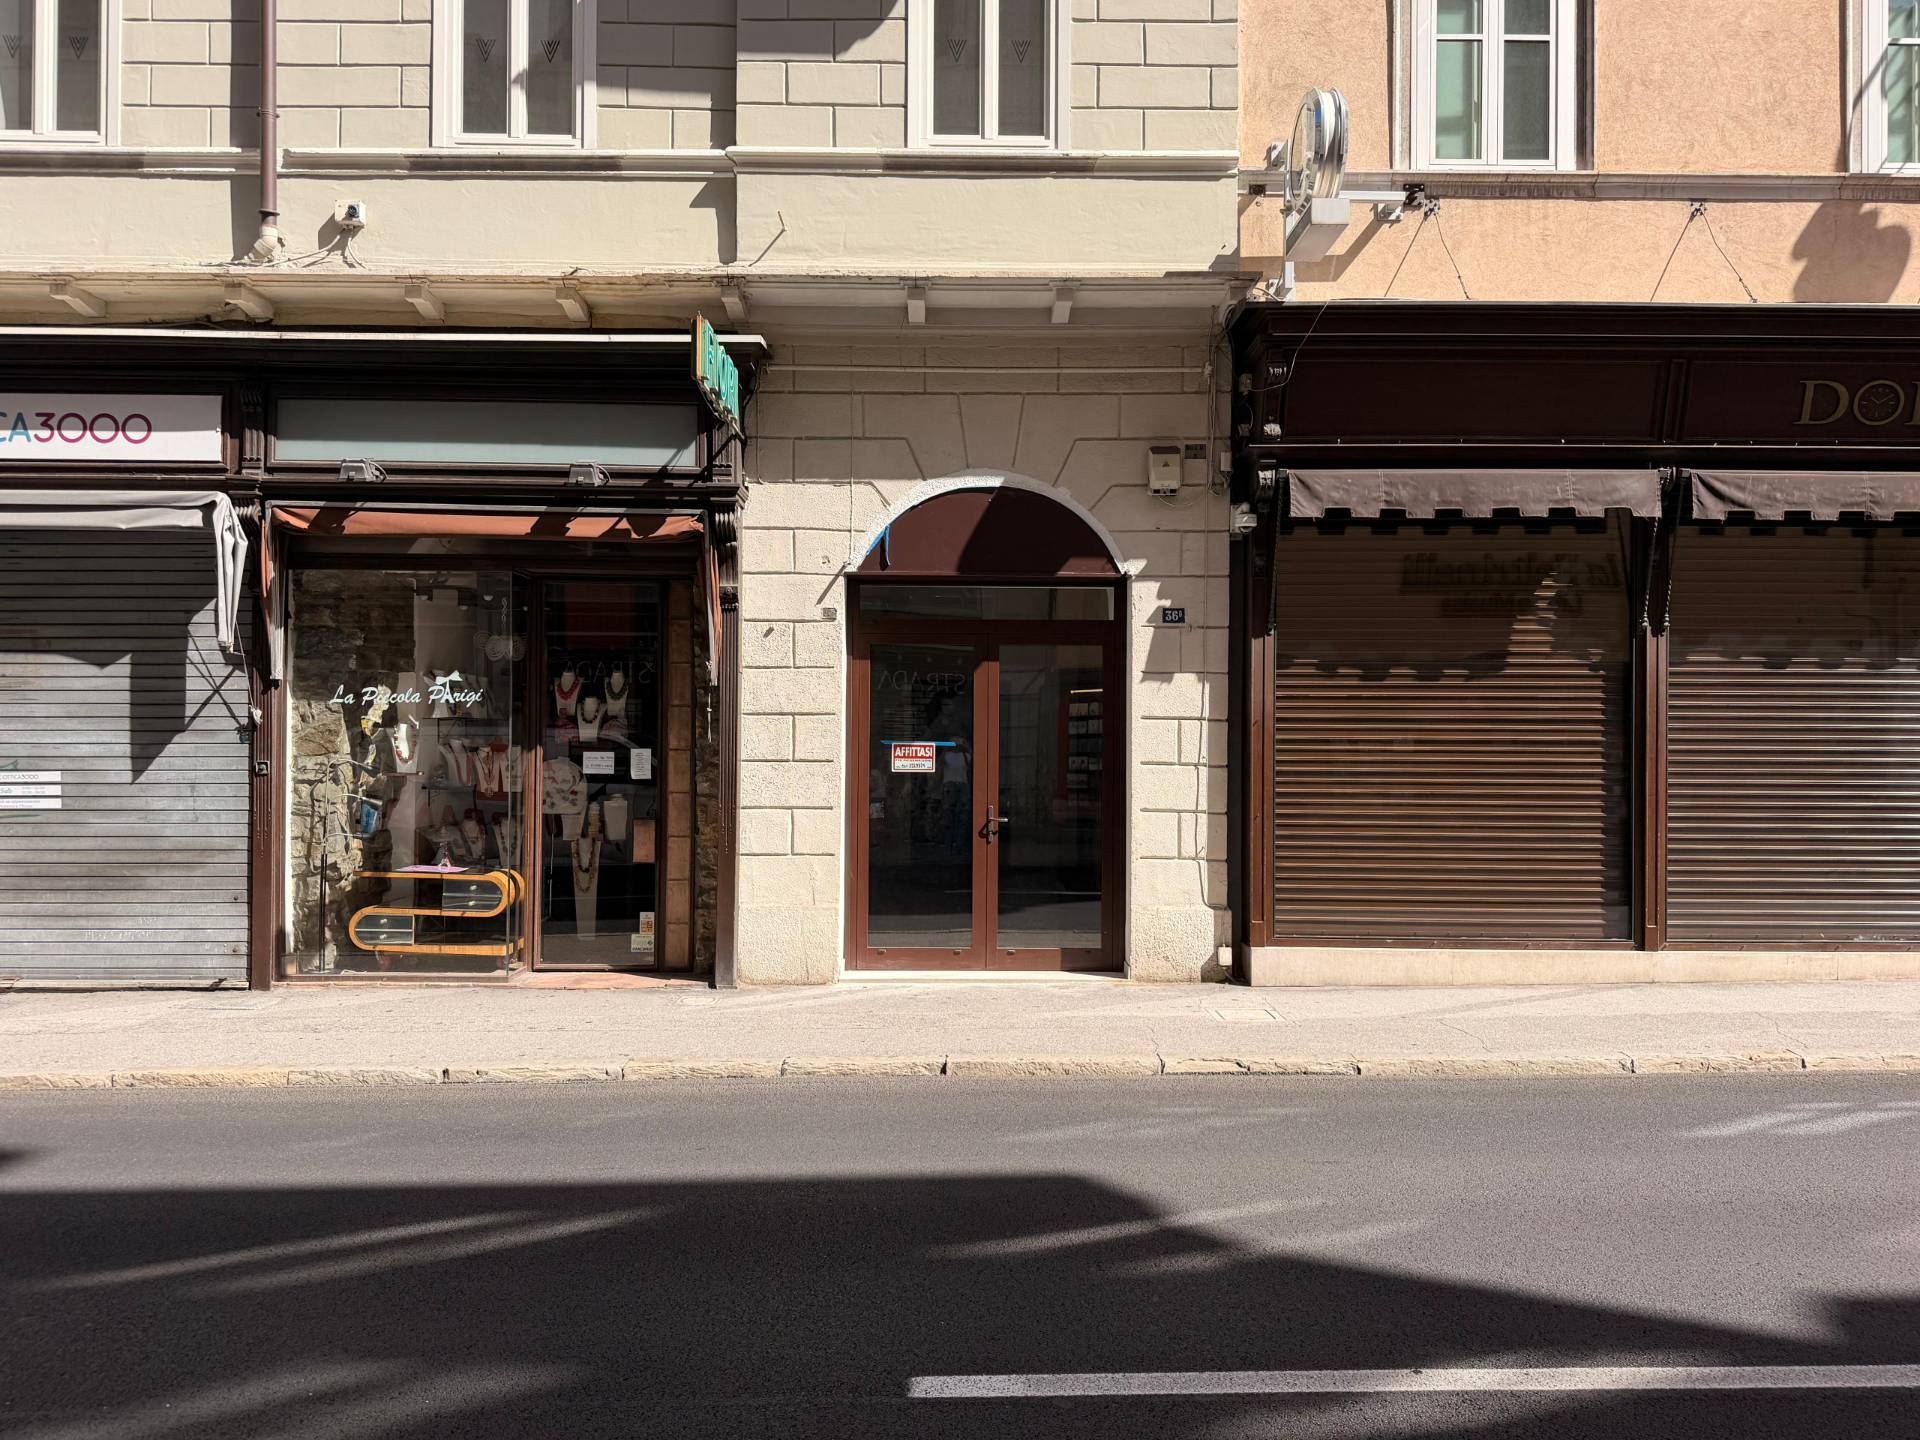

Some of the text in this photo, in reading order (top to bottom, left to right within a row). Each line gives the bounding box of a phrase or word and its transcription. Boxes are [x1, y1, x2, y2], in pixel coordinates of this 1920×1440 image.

[1792, 379, 1920, 426] DO
[0, 412, 152, 444] A3000
[329, 684, 356, 705] La
[361, 686, 422, 706] Piccola
[895, 746, 933, 757] AFFITTASI
